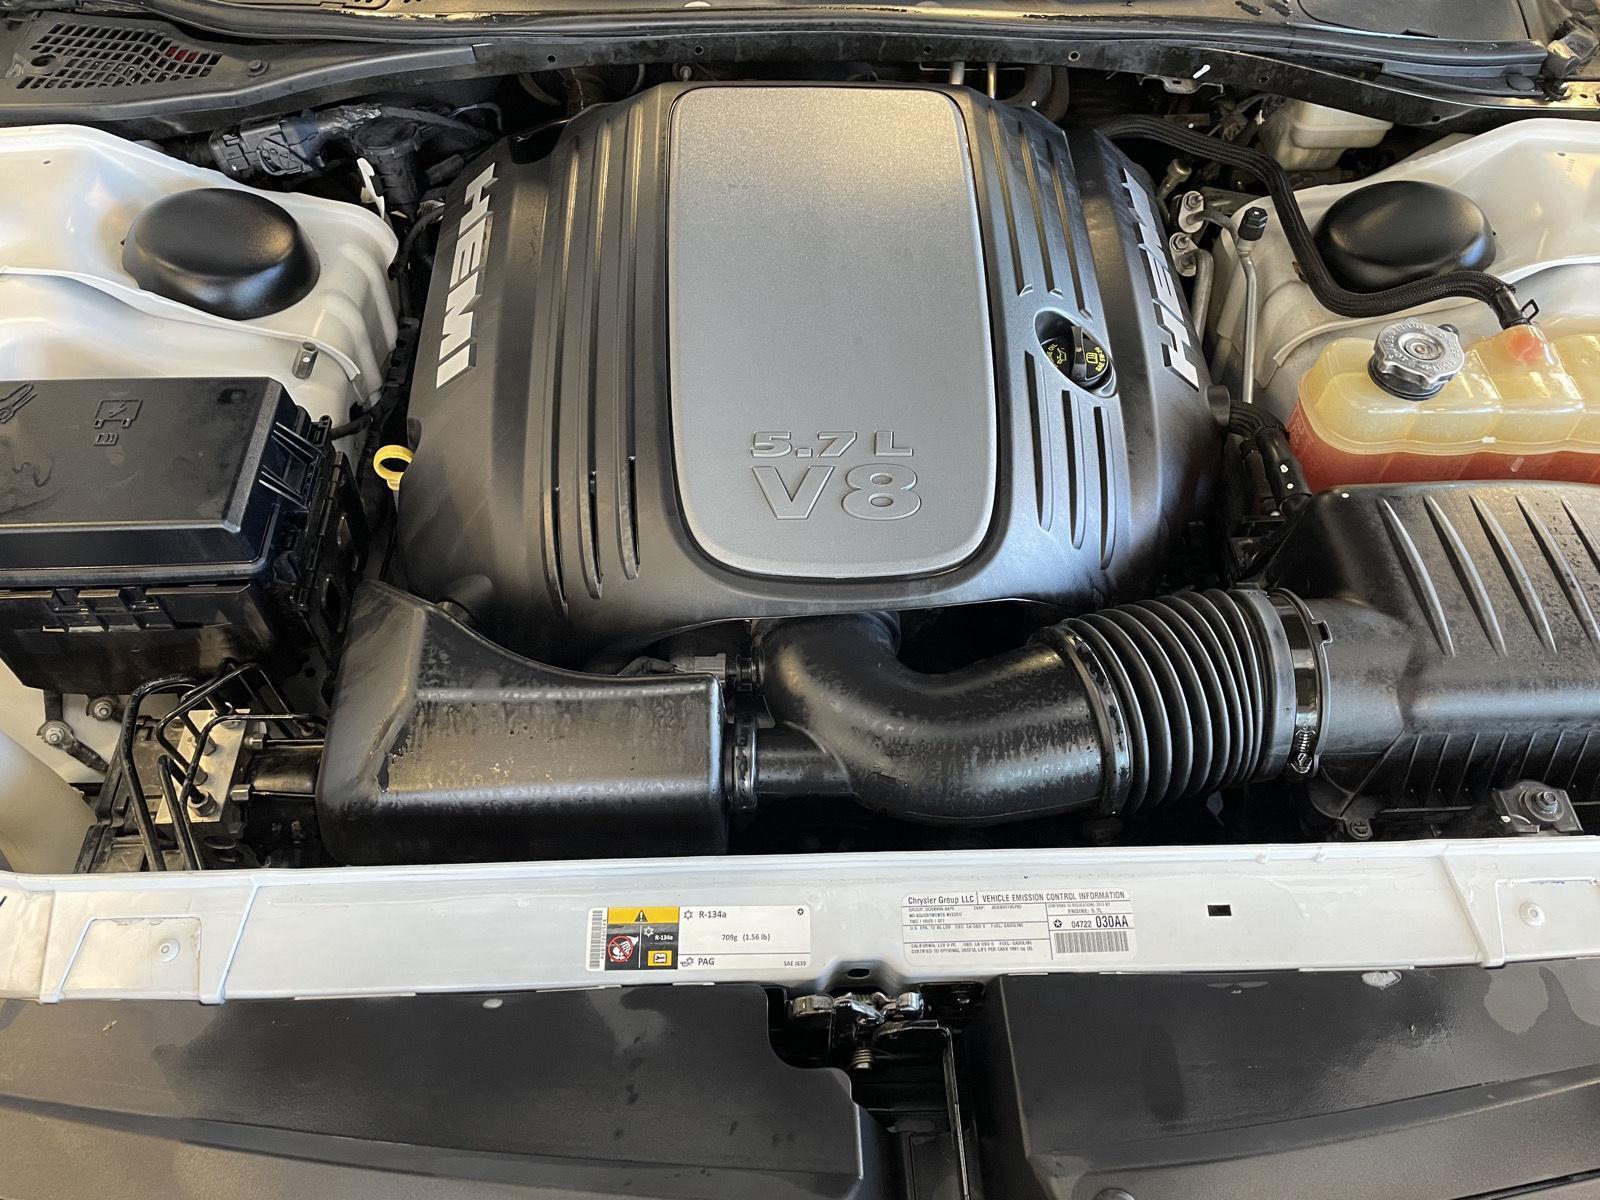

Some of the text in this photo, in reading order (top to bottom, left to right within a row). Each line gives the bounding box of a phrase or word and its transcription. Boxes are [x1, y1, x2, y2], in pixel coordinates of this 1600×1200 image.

[436, 162, 497, 389] HEMI
[1122, 167, 1200, 392] HEMI
[751, 462, 922, 522] V8
[907, 895, 975, 906] Chrysler Group LLC
[981, 891, 1125, 903] VEHICLE EMISSION CONTROL INFORMATION
[698, 910, 727, 919] R-134a
[1071, 915, 1129, 929] 04722 030AA
[721, 933, 771, 942] 709g (1.56 lb)
[698, 957, 715, 966] PAG
